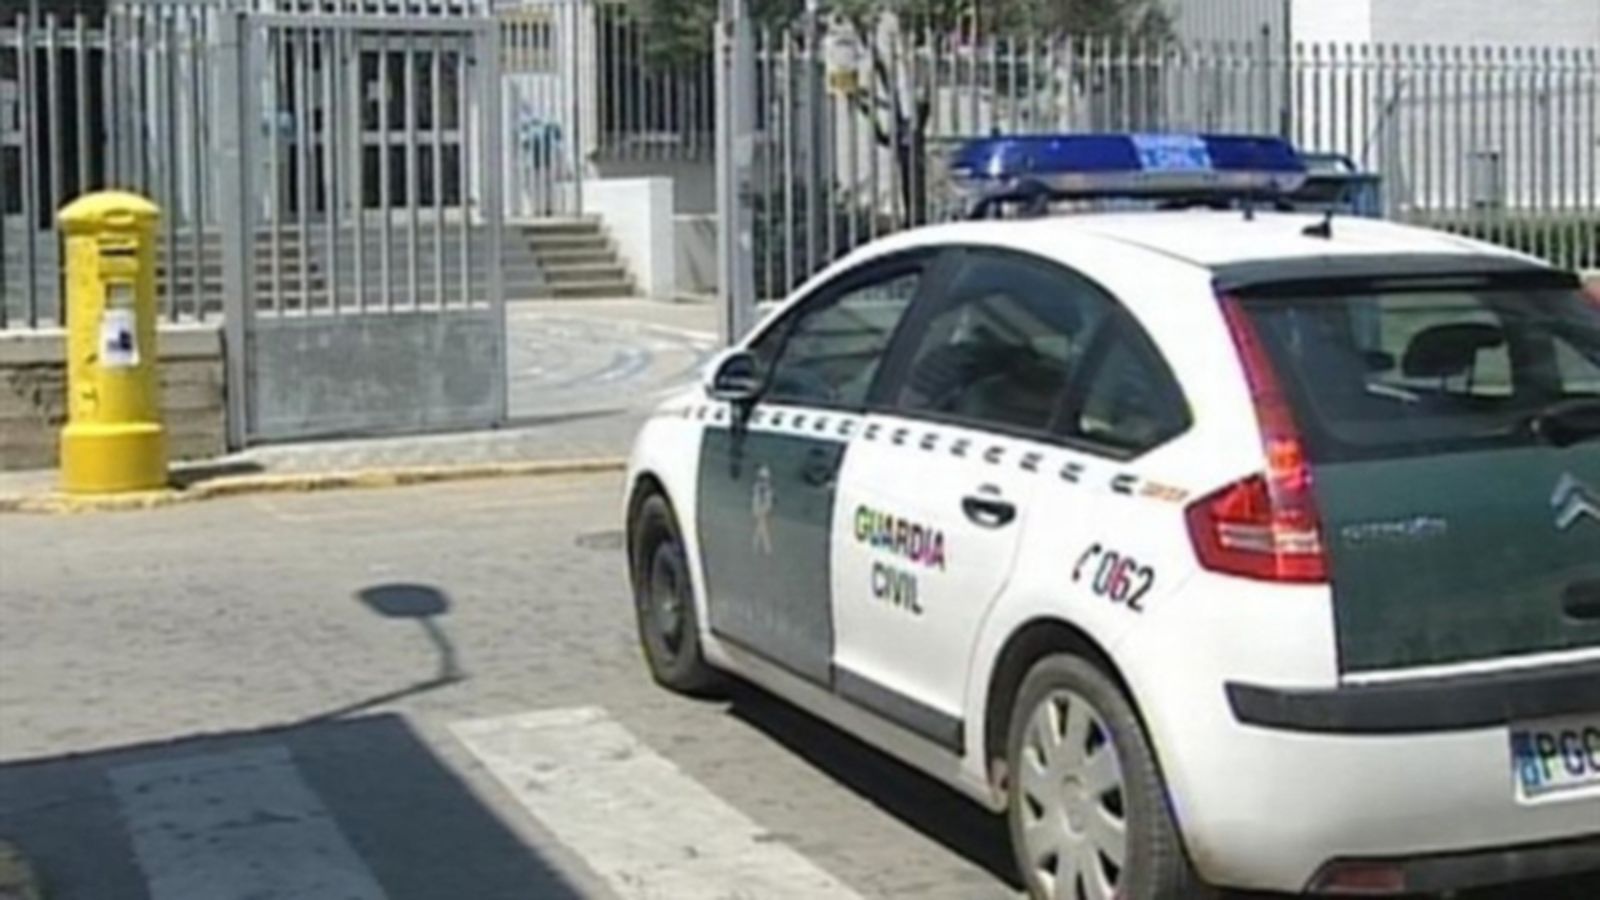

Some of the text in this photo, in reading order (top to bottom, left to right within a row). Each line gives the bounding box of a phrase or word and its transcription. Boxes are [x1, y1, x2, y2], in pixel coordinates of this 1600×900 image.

[854, 504, 945, 570] GUARDIA
[872, 562, 924, 615] CIVIL
[1092, 551, 1155, 612] 062
